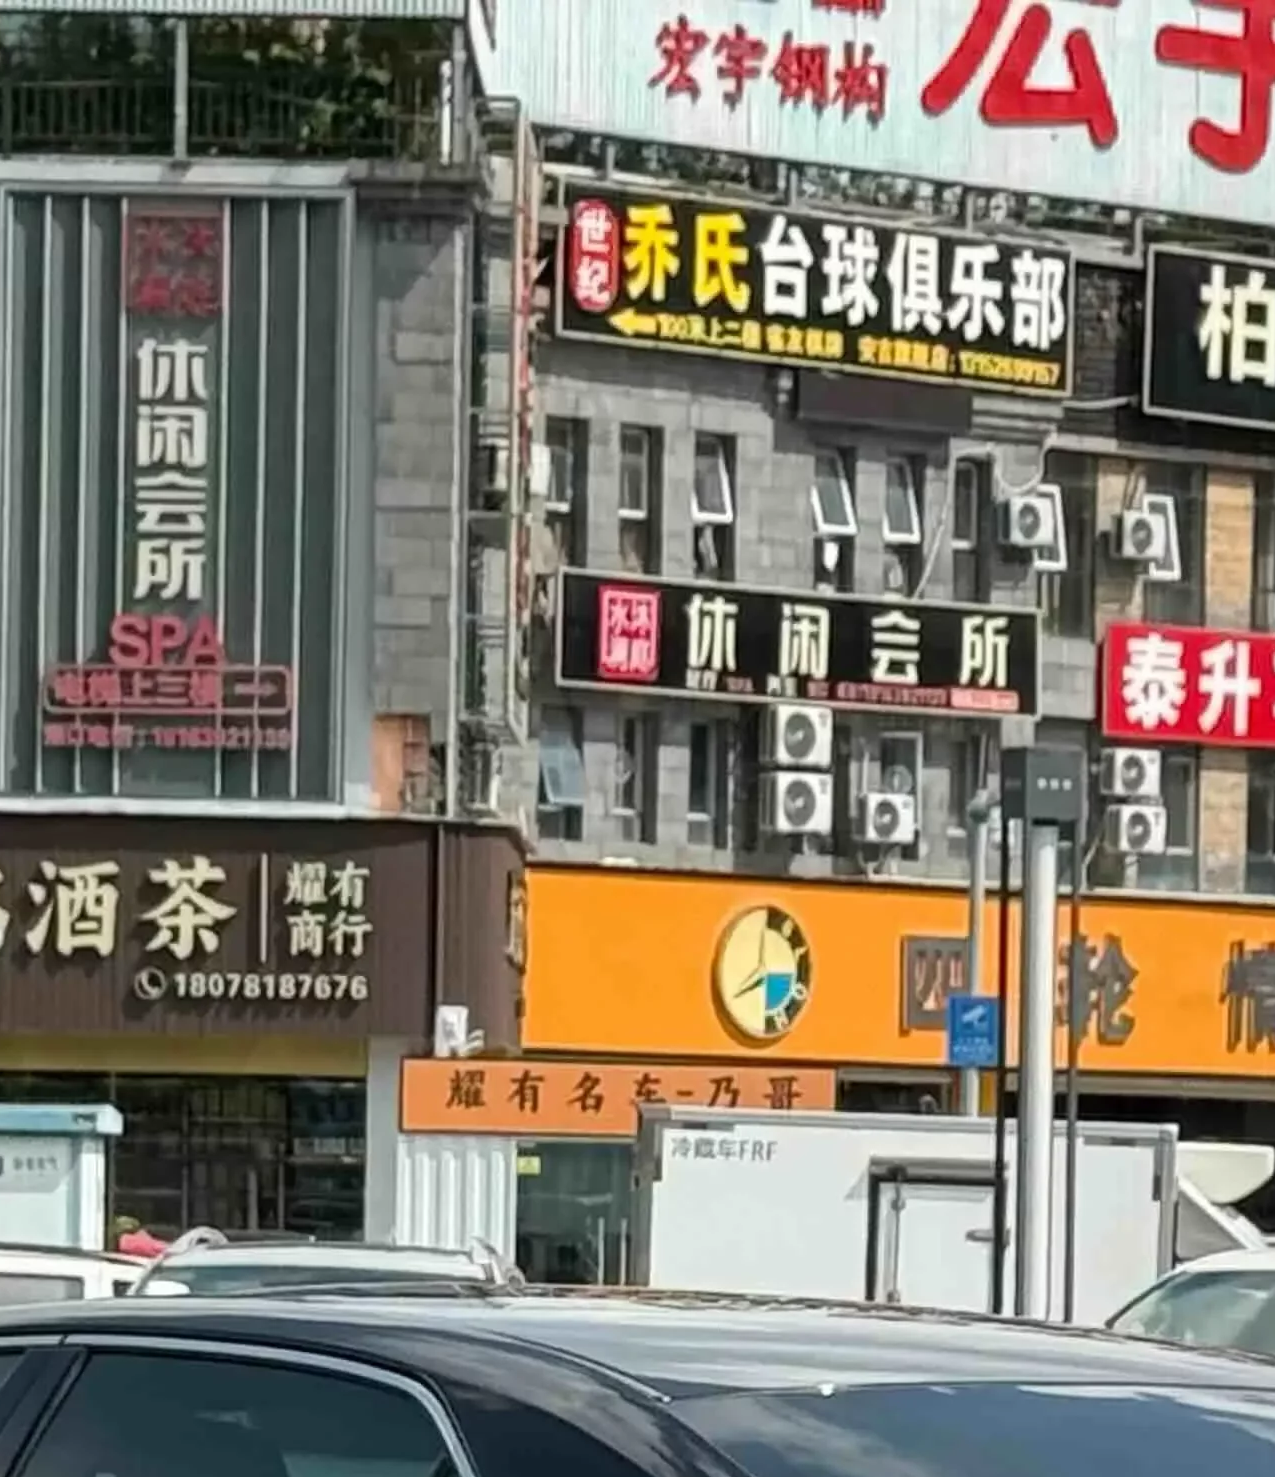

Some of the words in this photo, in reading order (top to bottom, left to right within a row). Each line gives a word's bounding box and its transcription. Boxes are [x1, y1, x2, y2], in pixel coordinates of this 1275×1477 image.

[574, 206, 616, 303] 世纪
[625, 203, 1068, 350] 乔氏台球俱乐部
[133, 338, 209, 602] 休闲会所
[109, 613, 225, 668] SPA
[685, 593, 1010, 688] 休闲会所
[283, 860, 371, 909] 耀有
[283, 909, 374, 957] 商行
[174, 972, 370, 1001] 18078187676
[670, 1137, 778, 1163] 冷藏车FRF
